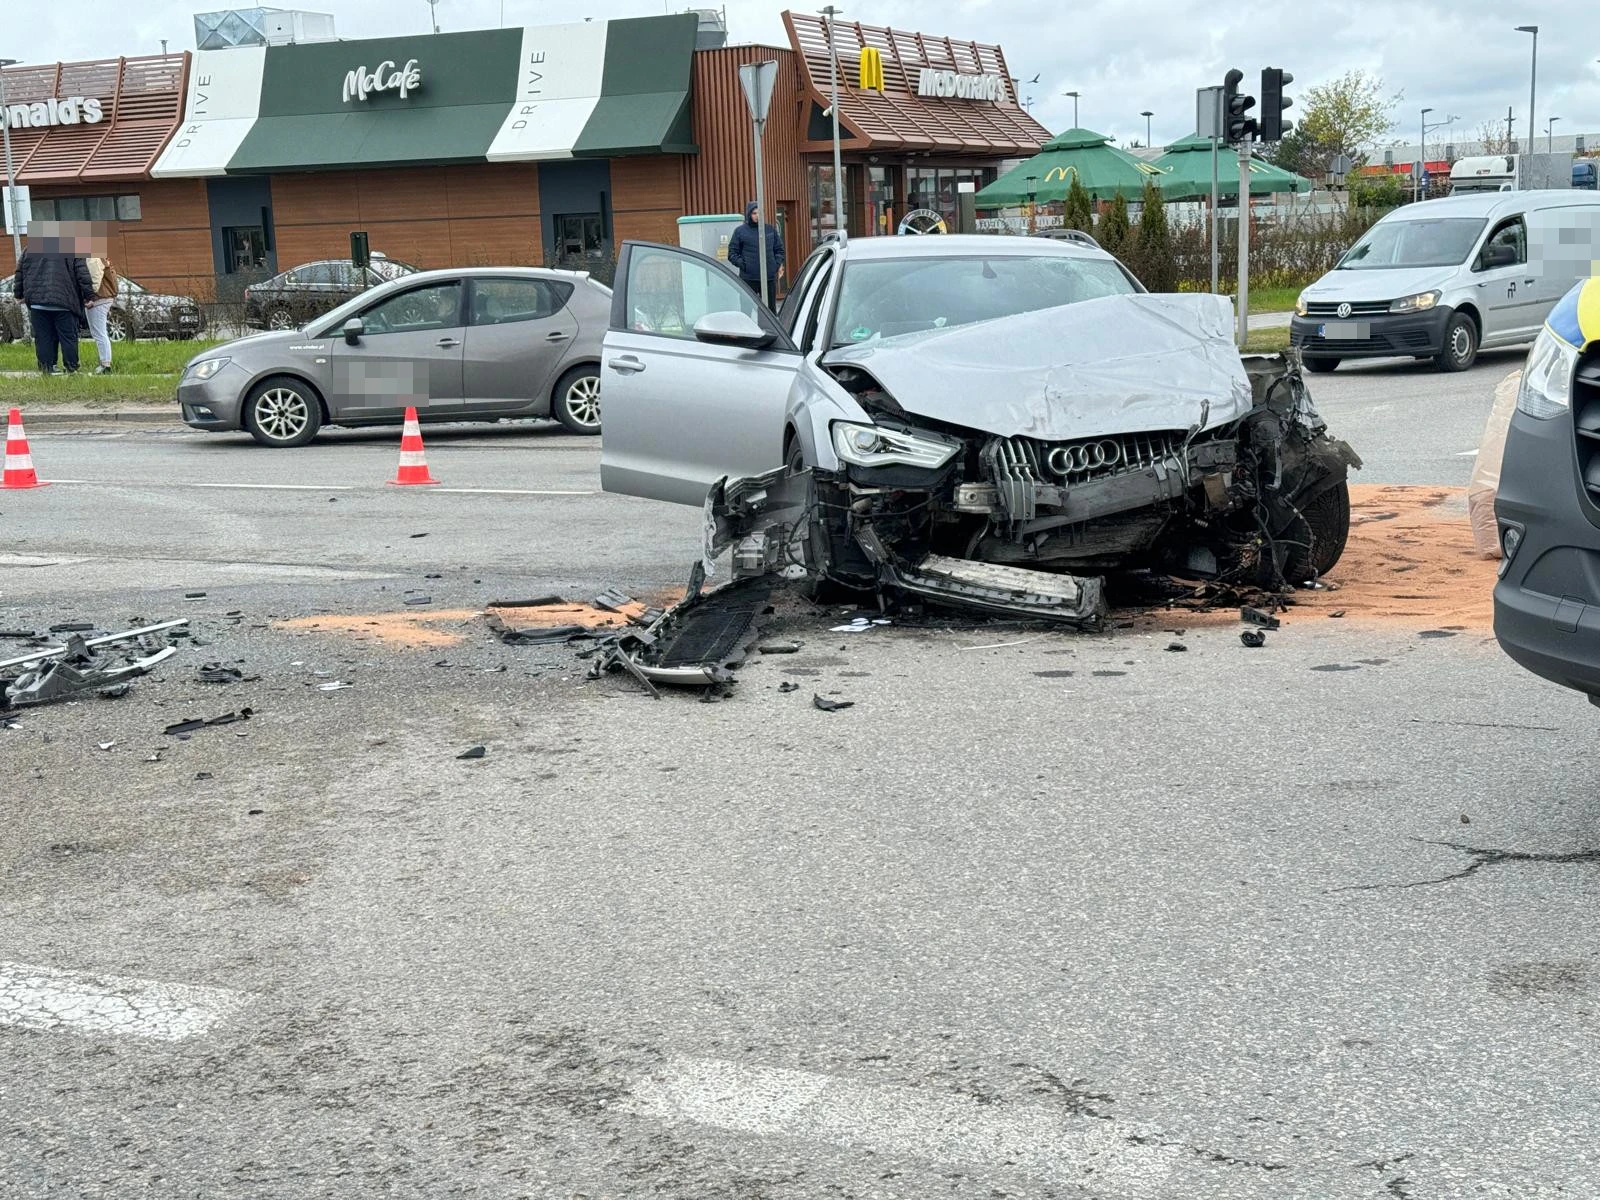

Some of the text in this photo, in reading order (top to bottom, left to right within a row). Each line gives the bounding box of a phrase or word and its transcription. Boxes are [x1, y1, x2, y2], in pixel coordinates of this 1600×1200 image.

[342, 58, 421, 103] McCafé
[511, 51, 546, 129] DRIVE
[917, 67, 1006, 102] McDonald's
[176, 75, 211, 148] DRIVE
